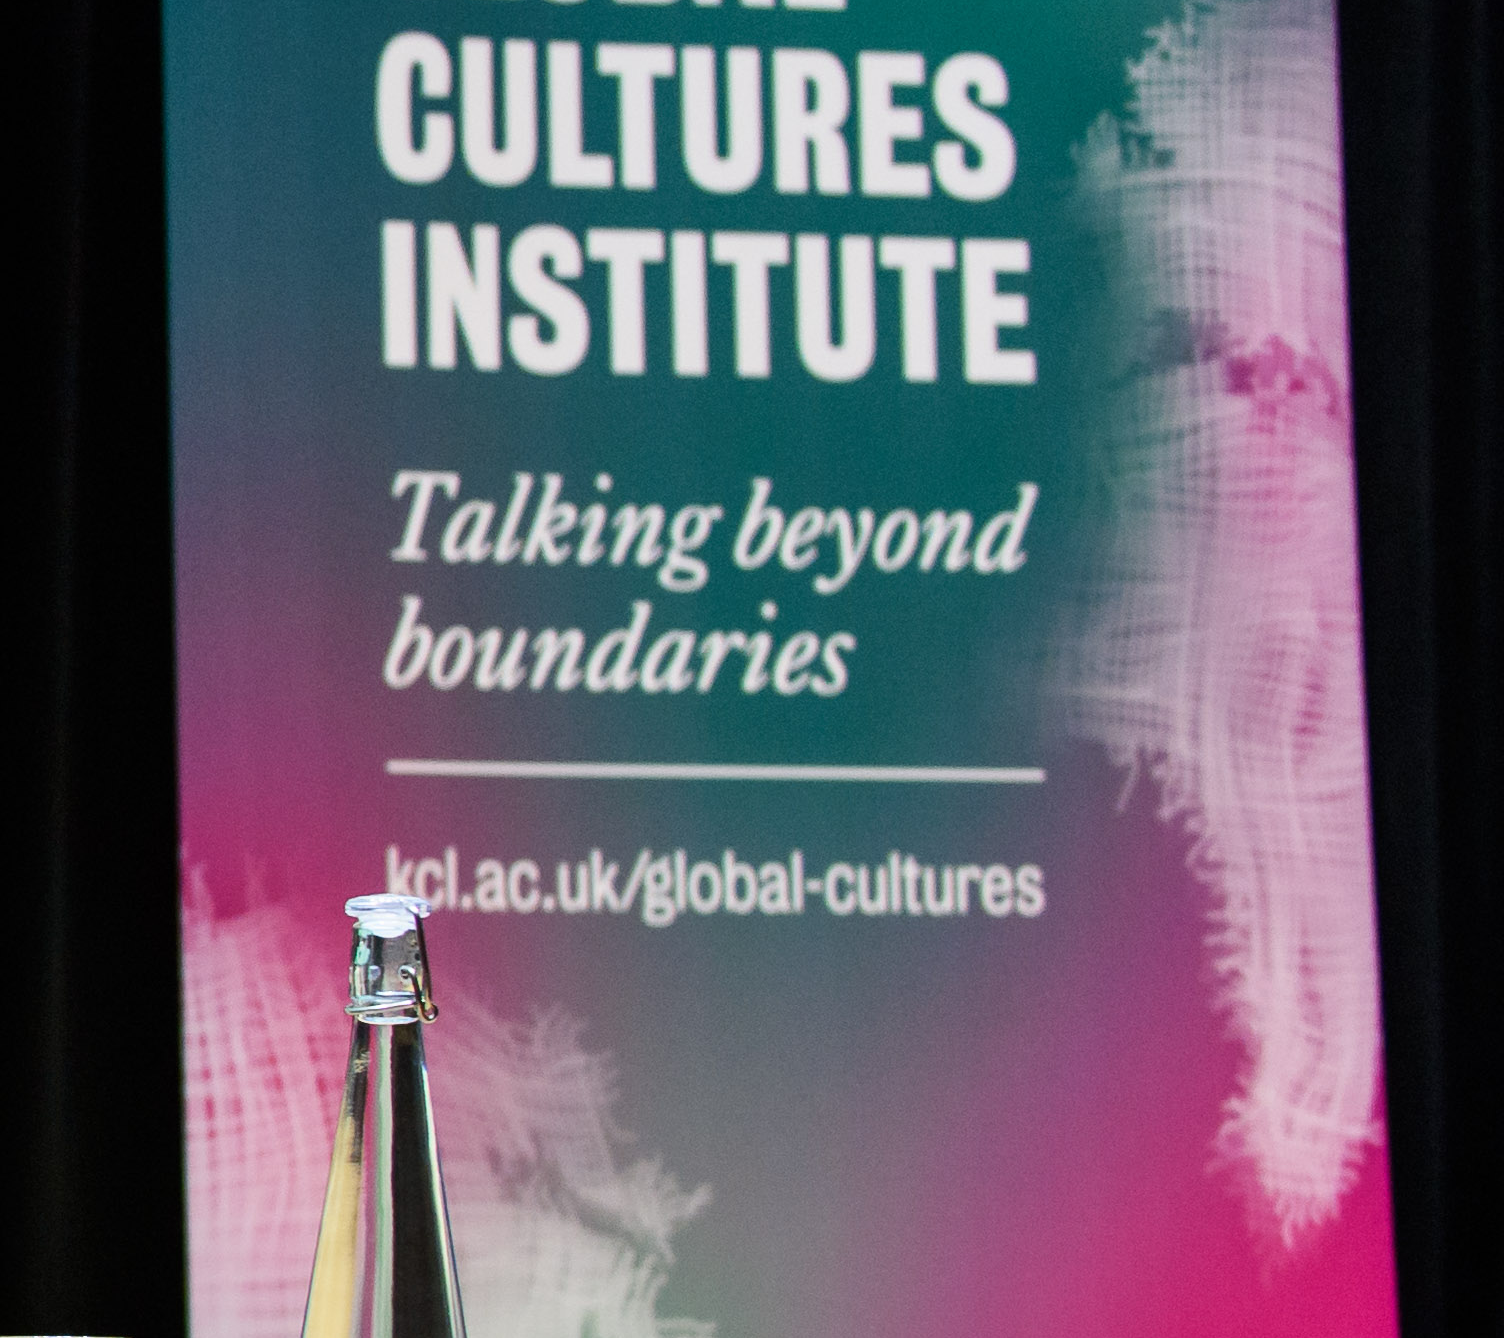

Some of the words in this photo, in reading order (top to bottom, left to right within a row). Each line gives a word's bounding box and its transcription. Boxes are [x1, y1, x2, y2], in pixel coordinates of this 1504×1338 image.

[374, 29, 1018, 202] CULTURES
[381, 219, 1038, 385] INSTITUTE
[389, 469, 723, 593] Talking
[731, 476, 1040, 594] beyond
[382, 595, 857, 697] boundaries
[385, 844, 1045, 927] kcl.ac.uk/global-cultures
